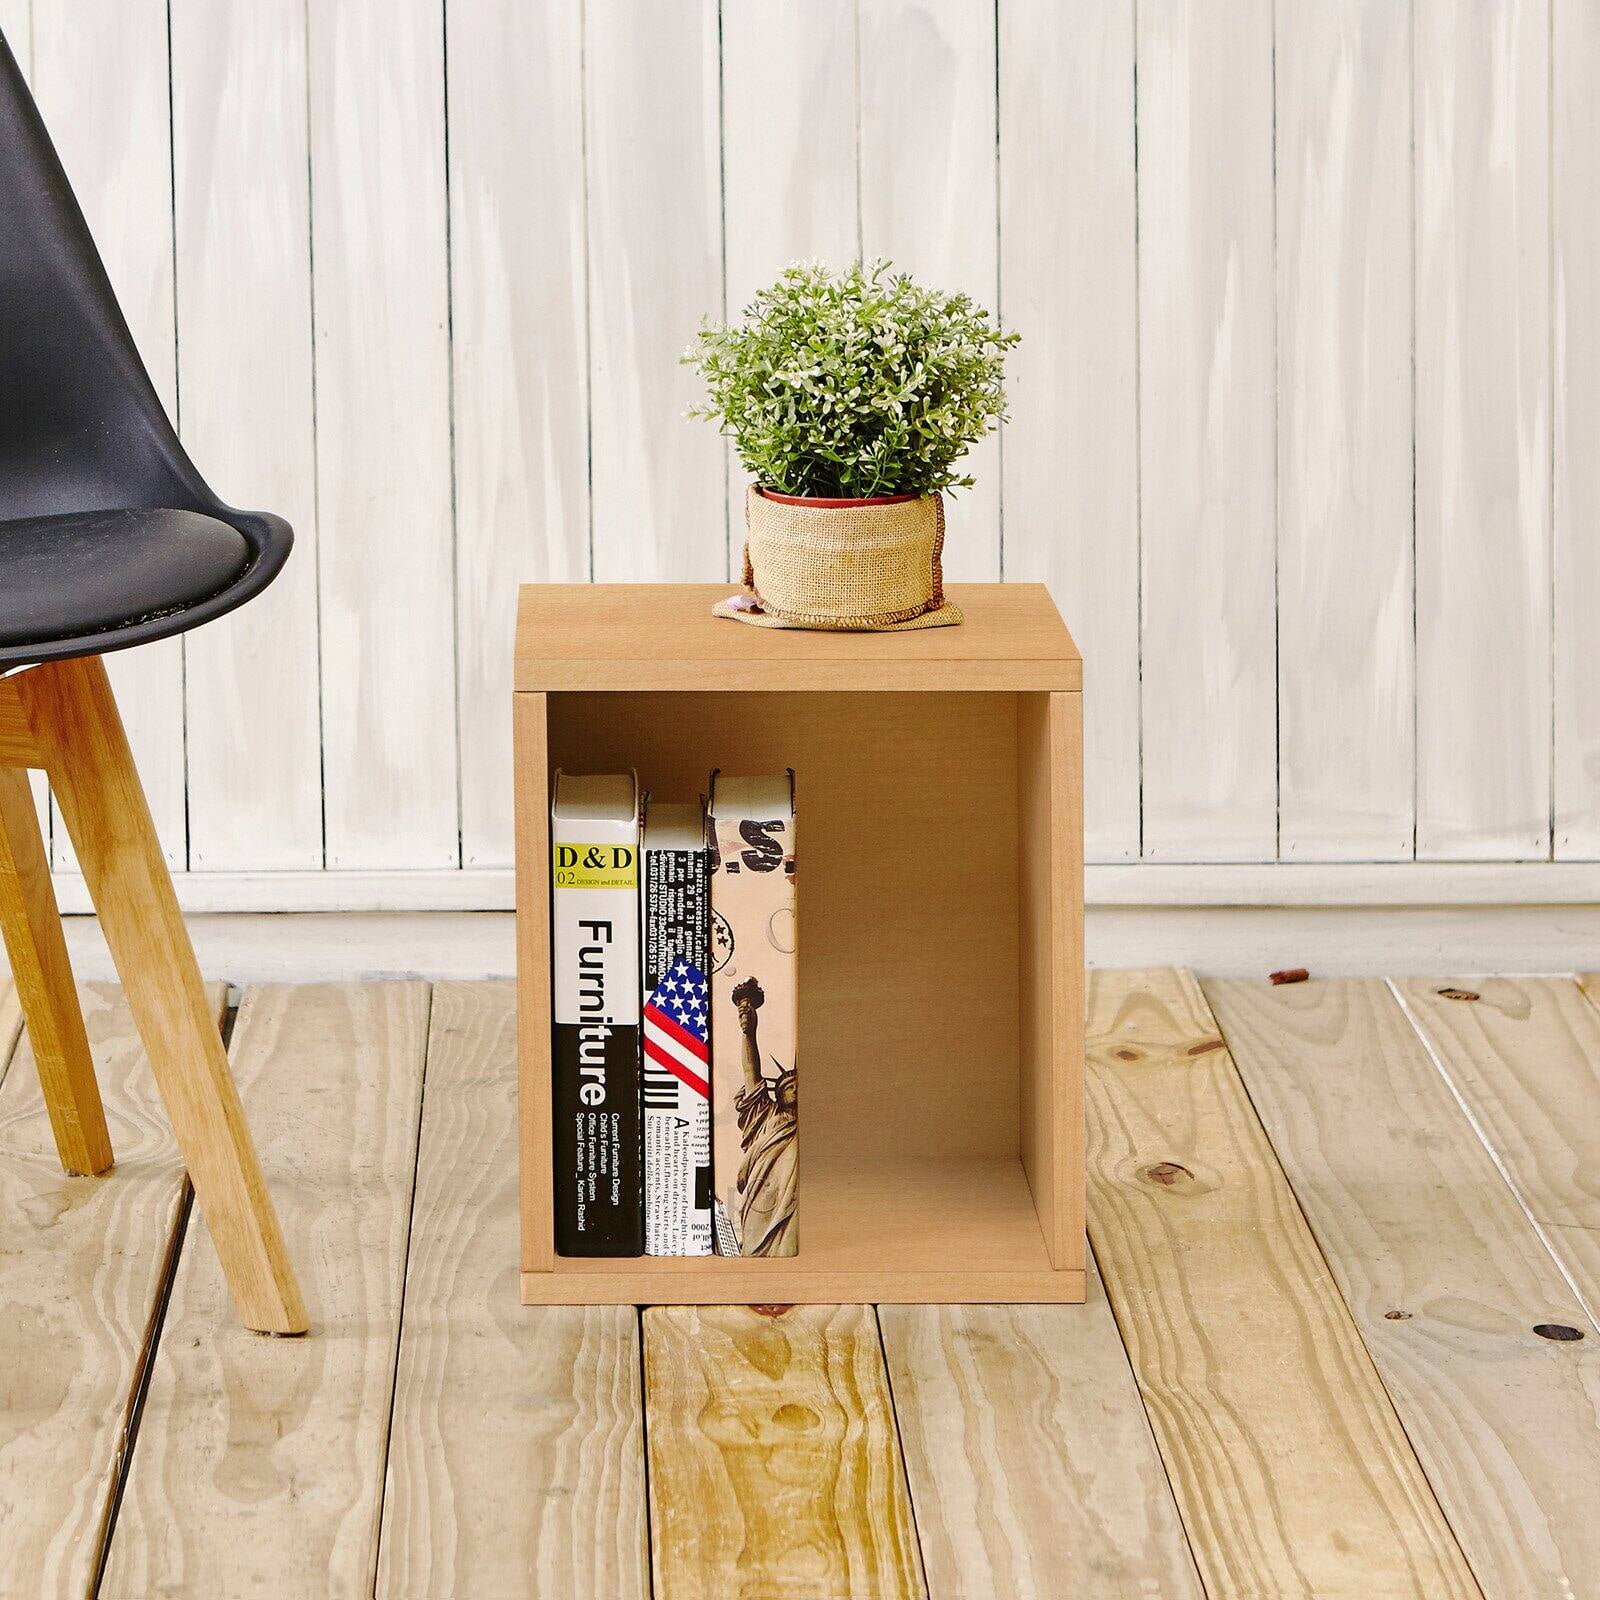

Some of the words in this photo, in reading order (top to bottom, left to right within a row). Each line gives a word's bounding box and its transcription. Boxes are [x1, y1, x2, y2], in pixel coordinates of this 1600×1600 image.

[557, 846, 578, 867] D
[583, 847, 606, 869] &
[611, 847, 632, 869] D
[667, 852, 677, 883] gennaio
[676, 868, 685, 882] per
[658, 884, 668, 915] STUDIO
[686, 884, 695, 895] 29
[667, 888, 677, 922] rispedire
[677, 888, 685, 921] vendere
[686, 901, 695, 909] al
[686, 914, 695, 924] 31
[675, 926, 685, 955] meglio
[579, 920, 613, 1106] Furniture
[575, 1112, 585, 1141] Special
[588, 1112, 597, 1135] Office
[600, 1112, 609, 1139] Child's
[611, 1112, 620, 1142] Current
[647, 1115, 655, 1129] Sui
[664, 1116, 672, 1151] beneath
[673, 1130, 681, 1147] and
[577, 1142, 585, 1172] Feature
[589, 1137, 597, 1171] Furniture
[600, 1140, 609, 1174] Furniture
[612, 1143, 621, 1177] Furniture
[673, 1149, 681, 1177] hearts
[674, 1116, 690, 1129] A
[682, 1195, 689, 1204] of
[577, 1180, 585, 1202] Karim
[587, 1172, 597, 1201] System
[611, 1178, 621, 1206] Design
[673, 1178, 679, 1190] on
[646, 1182, 654, 1221] bambine
[577, 1204, 586, 1231] Rashid
[663, 1206, 671, 1231] skirts
[691, 1223, 710, 1231] 2000
[672, 1228, 680, 1248] Lace
